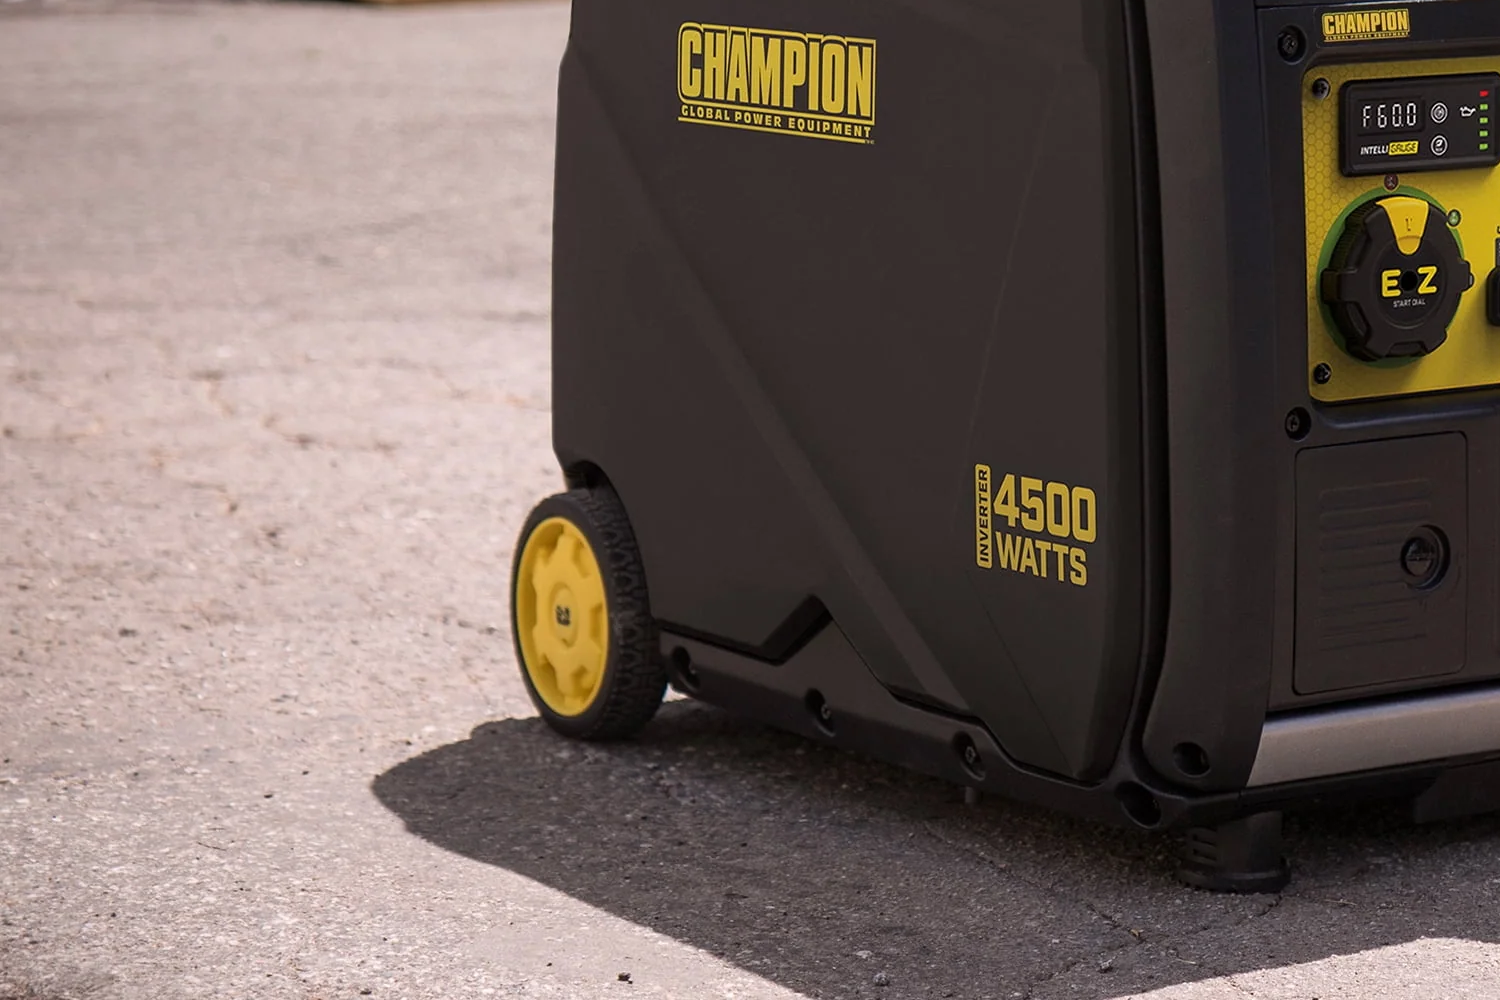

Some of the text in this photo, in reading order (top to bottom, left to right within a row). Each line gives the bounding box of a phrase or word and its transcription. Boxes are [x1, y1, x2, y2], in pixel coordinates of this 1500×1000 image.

[1323, 10, 1408, 36] CHAMPION
[680, 28, 873, 118] CHAMPION
[681, 104, 872, 138] GLOBAL POWER EQUIPMENT
[1393, 299, 1412, 308] START
[978, 468, 989, 563] INVERTER
[993, 472, 1097, 543] 4500
[995, 530, 1088, 587] WATTS
